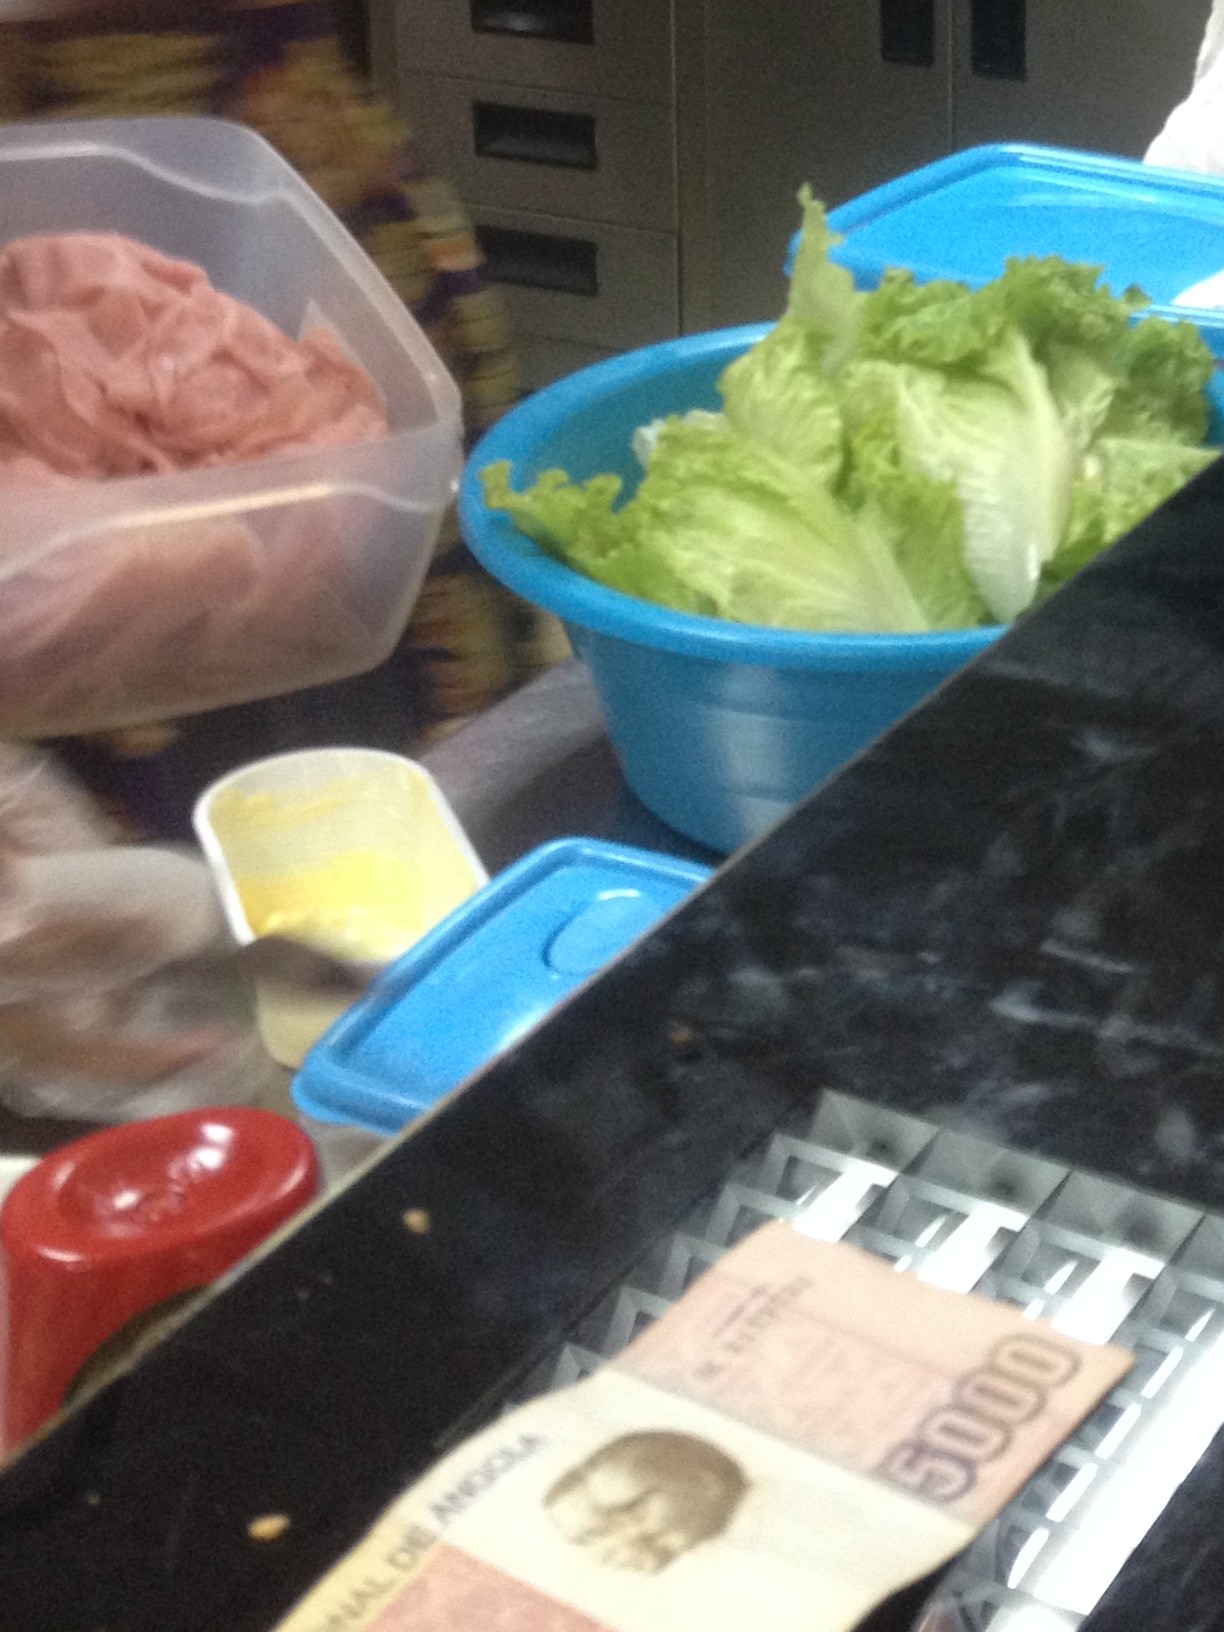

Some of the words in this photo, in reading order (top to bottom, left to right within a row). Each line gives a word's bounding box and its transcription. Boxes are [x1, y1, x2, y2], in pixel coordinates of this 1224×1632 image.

[877, 1331, 1083, 1506] 5000
[385, 1522, 439, 1573] DE
[429, 1432, 550, 1526] ANGOLA
